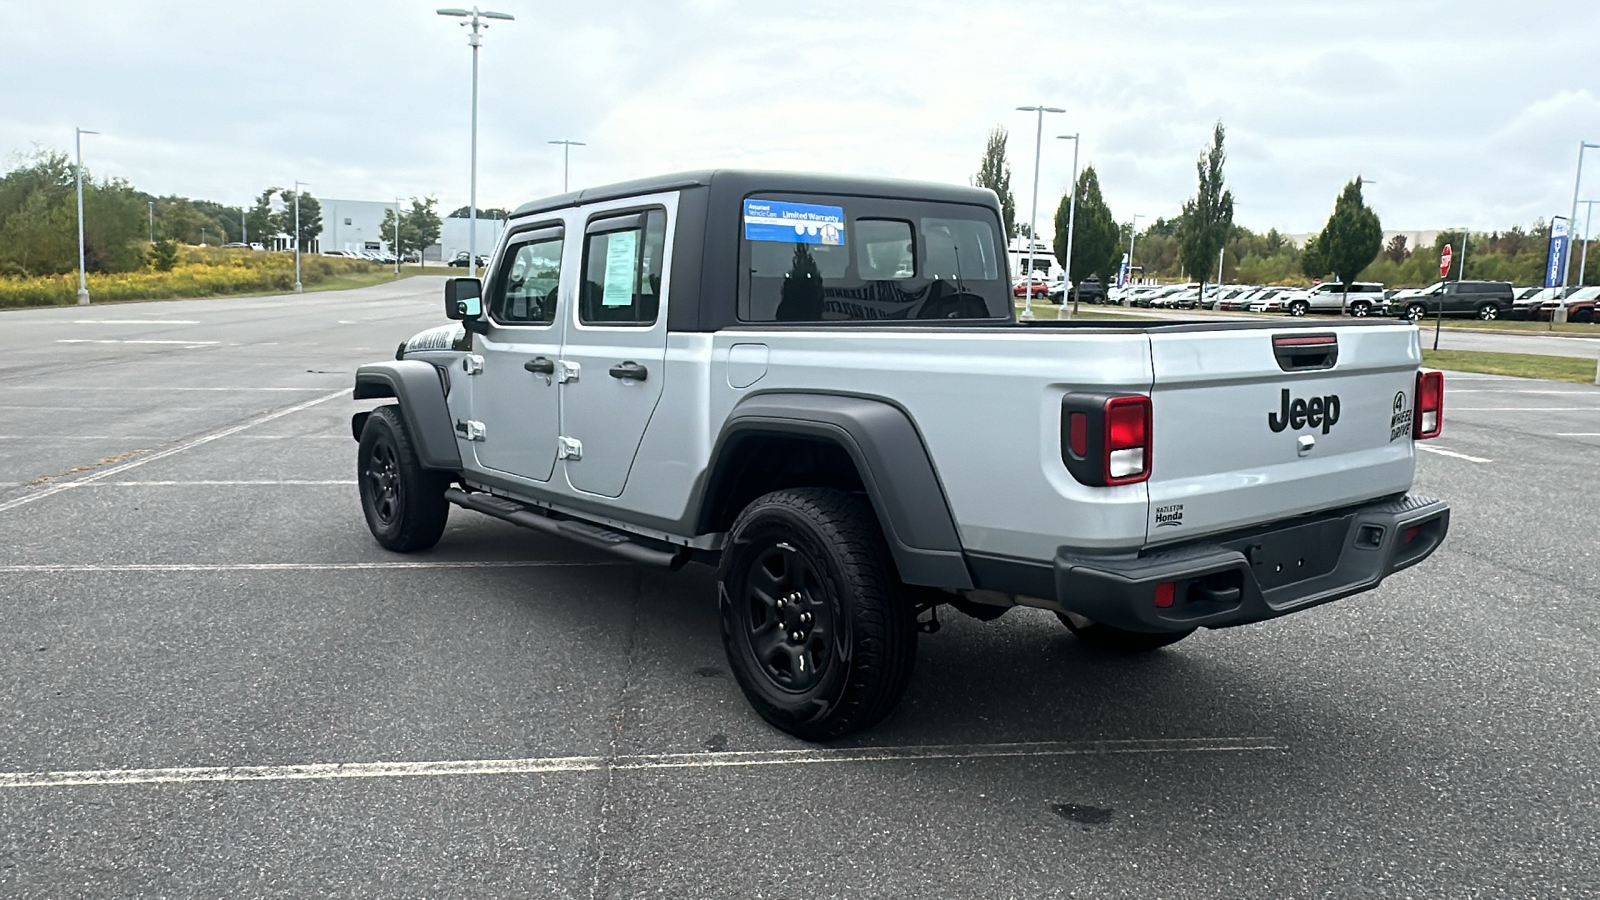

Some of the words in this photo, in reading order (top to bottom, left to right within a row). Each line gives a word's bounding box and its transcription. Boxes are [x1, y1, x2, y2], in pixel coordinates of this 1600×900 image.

[782, 210, 807, 219] Limited
[808, 212, 839, 223] Warranty
[1550, 238, 1562, 287] HYUNDAI
[1268, 388, 1341, 435] Jeep
[1390, 408, 1412, 429] WHEEL
[1389, 423, 1411, 443] DRIVE
[1155, 504, 1184, 514] HAZLETON
[1155, 511, 1183, 523] Honda
